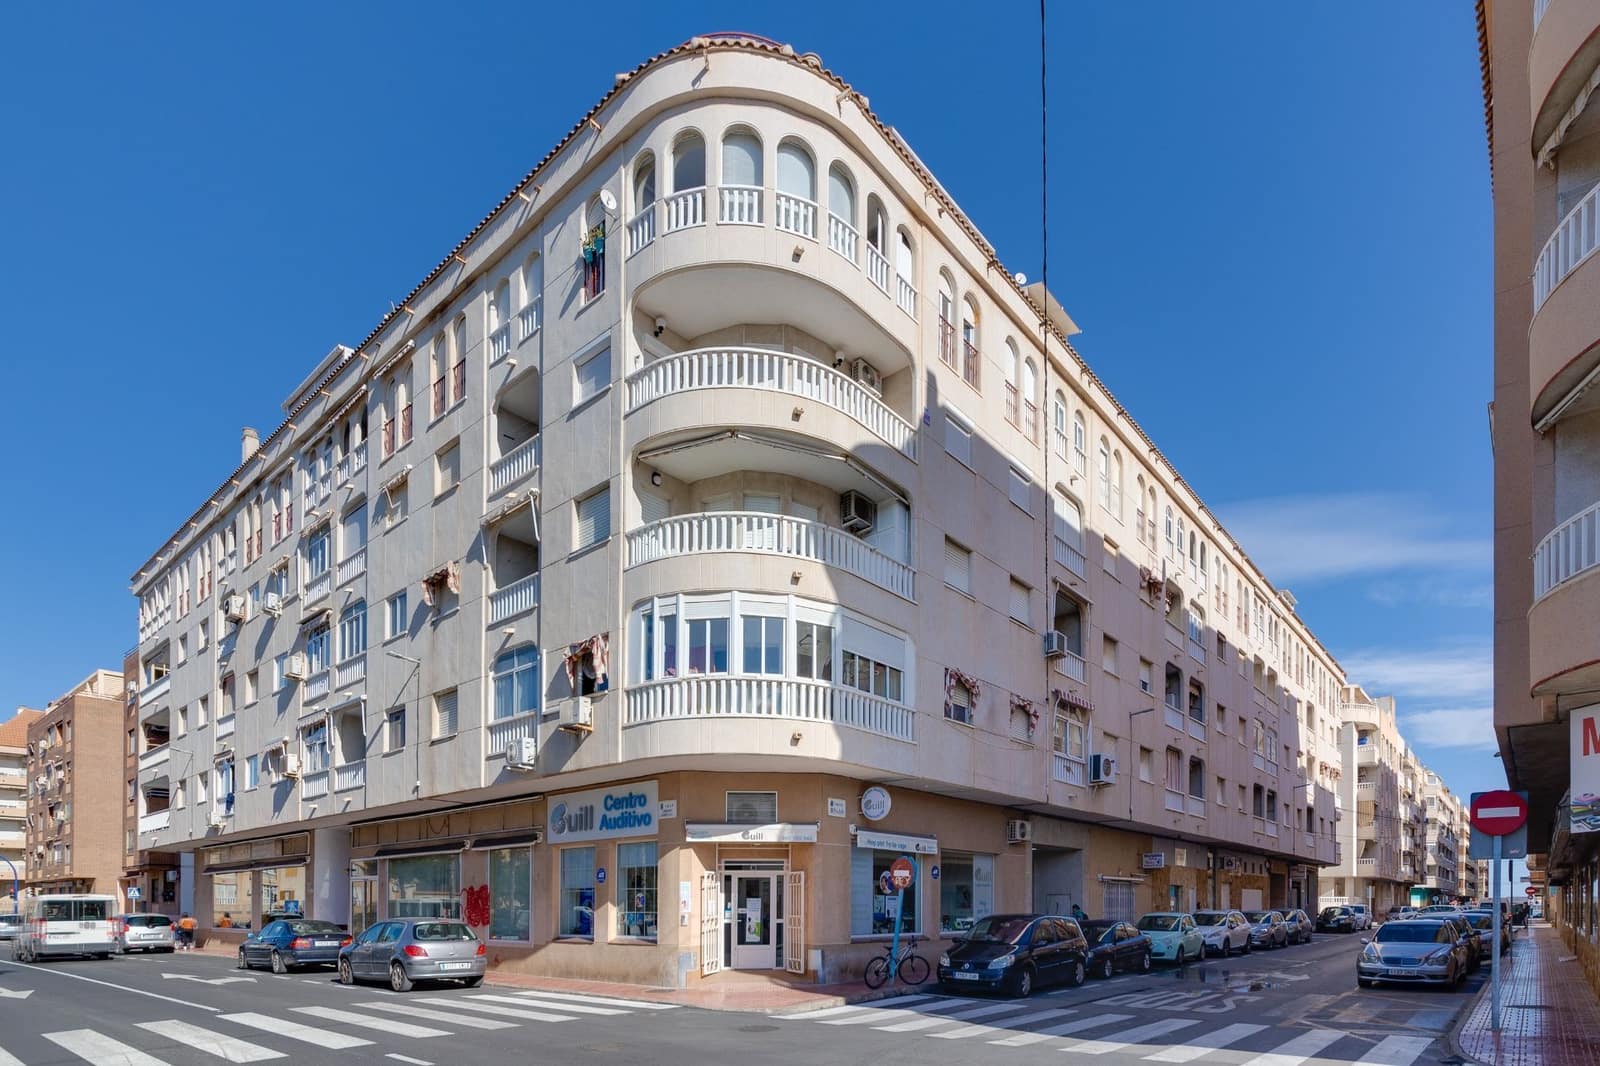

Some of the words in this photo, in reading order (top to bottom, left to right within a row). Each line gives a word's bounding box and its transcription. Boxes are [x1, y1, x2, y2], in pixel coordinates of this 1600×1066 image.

[604, 792, 647, 811] Centro
[551, 801, 594, 834] Guill
[599, 811, 652, 830] Auditivo
[741, 830, 764, 841] Guill
